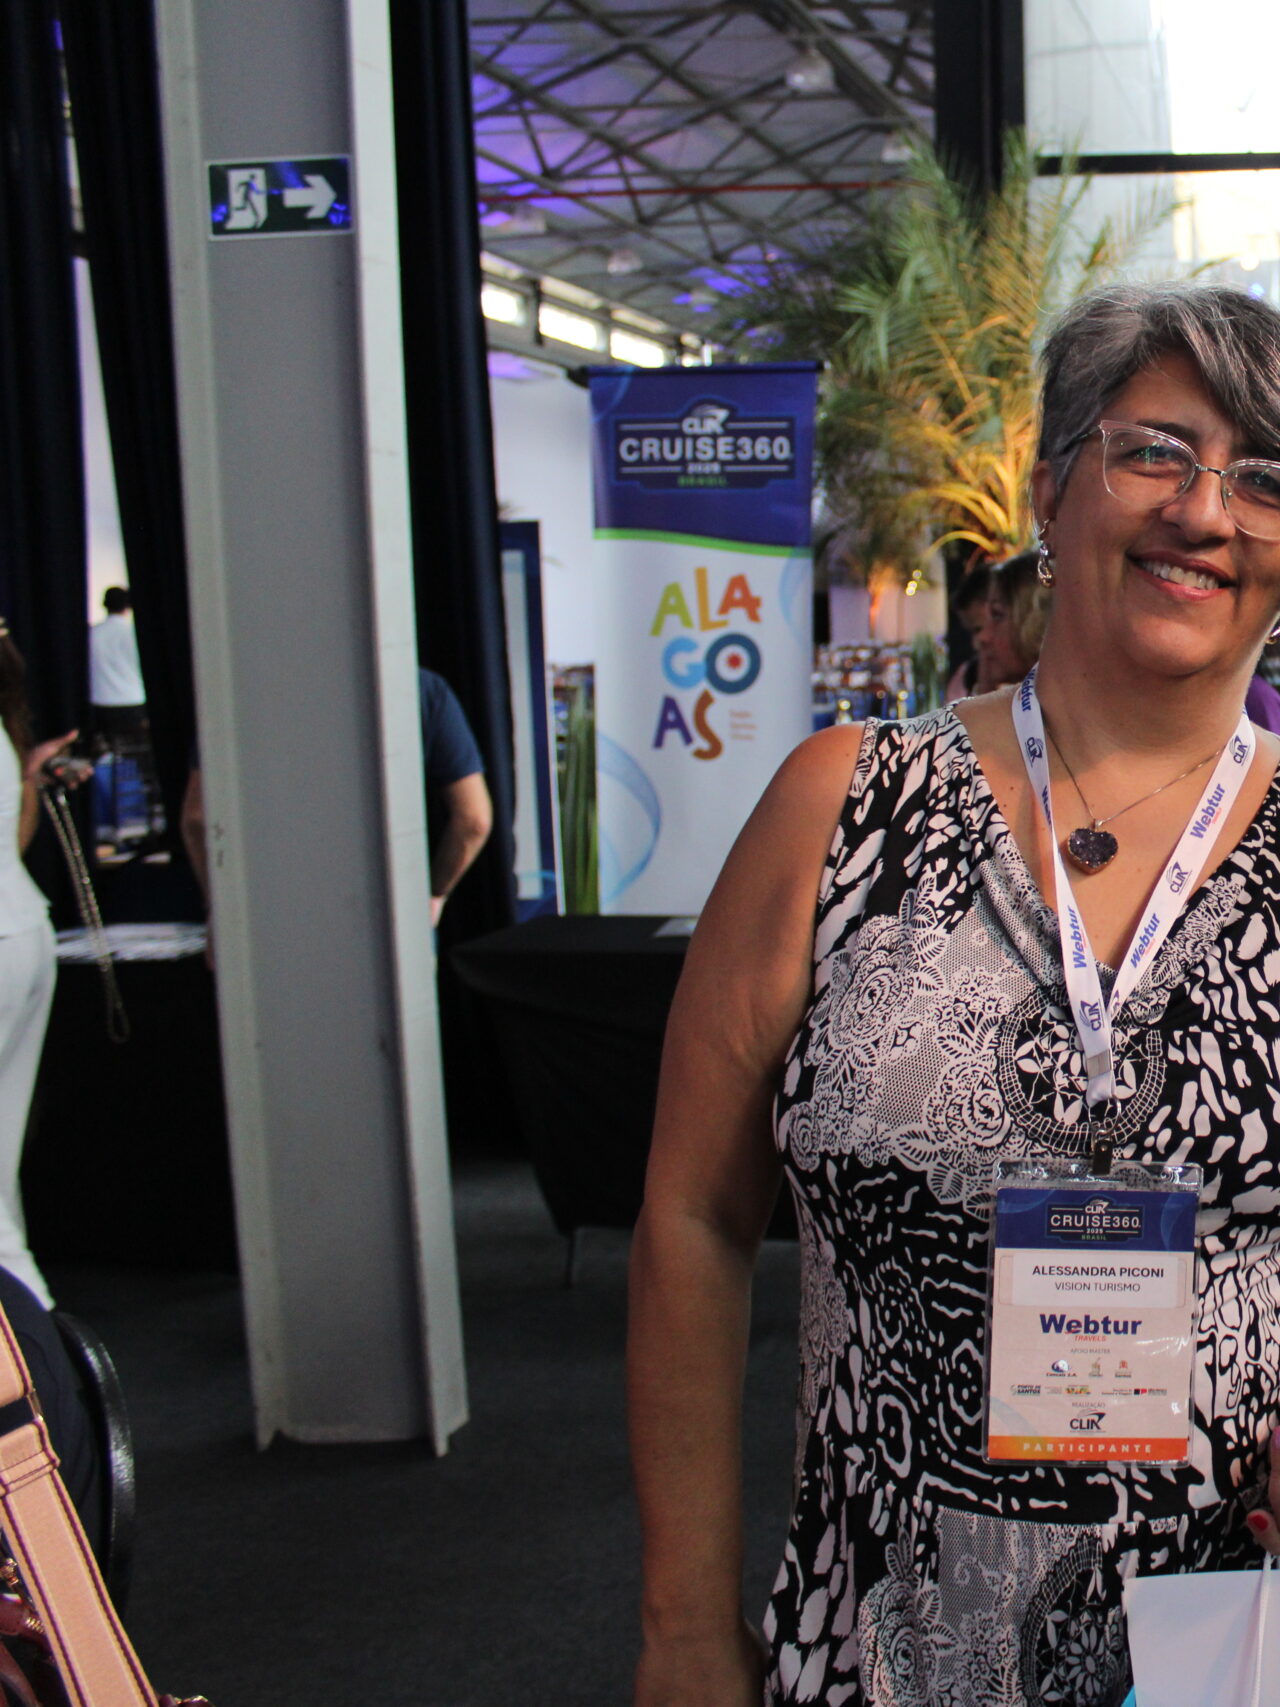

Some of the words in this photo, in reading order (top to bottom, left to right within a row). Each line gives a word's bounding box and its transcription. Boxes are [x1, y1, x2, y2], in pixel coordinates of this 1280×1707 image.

[619, 436, 792, 462] CRUISE360
[1190, 783, 1226, 839] Webtur
[1068, 905, 1087, 969] Webtur
[1130, 913, 1161, 969] Webtur
[1050, 1214, 1140, 1228] CRUISE360
[1032, 1265, 1117, 1277] ALESSANDRA
[1119, 1266, 1165, 1278] PICONI
[1055, 1282, 1091, 1291] VISION
[1094, 1283, 1141, 1293] TURISMO
[1039, 1313, 1143, 1335] Webtur
[1023, 1442, 1152, 1454] PARTICIPANTE
